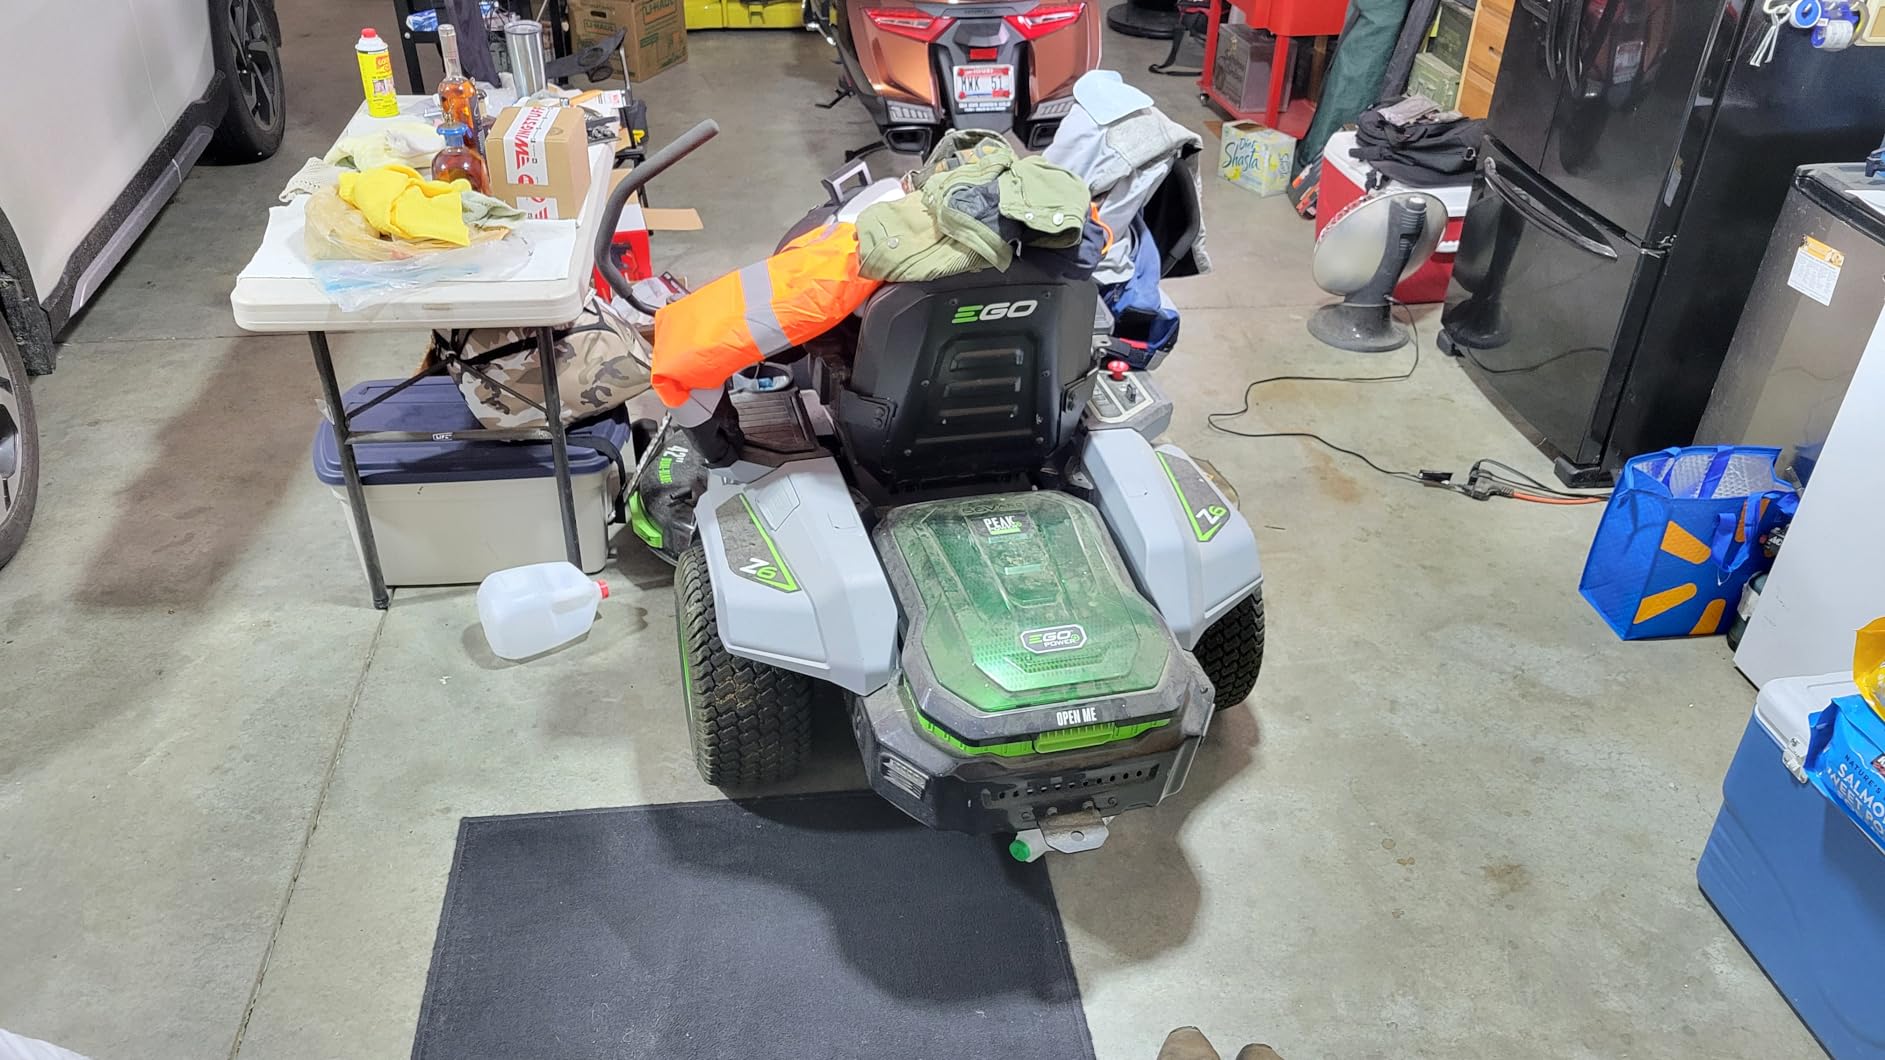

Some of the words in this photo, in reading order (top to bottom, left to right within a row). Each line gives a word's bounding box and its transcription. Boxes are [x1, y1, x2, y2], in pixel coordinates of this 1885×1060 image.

[1222, 142, 1261, 171] Shasta
[951, 300, 1038, 324] EGO
[983, 515, 1016, 532] PEAK
[1195, 505, 1227, 525] Z6
[739, 557, 777, 579] Z6
[1029, 629, 1071, 645] EGO
[1056, 709, 1081, 727] OPEN
[1082, 707, 1097, 723] ME
[1844, 754, 1882, 794] NATURE'S
[1826, 767, 1864, 812] WEET
